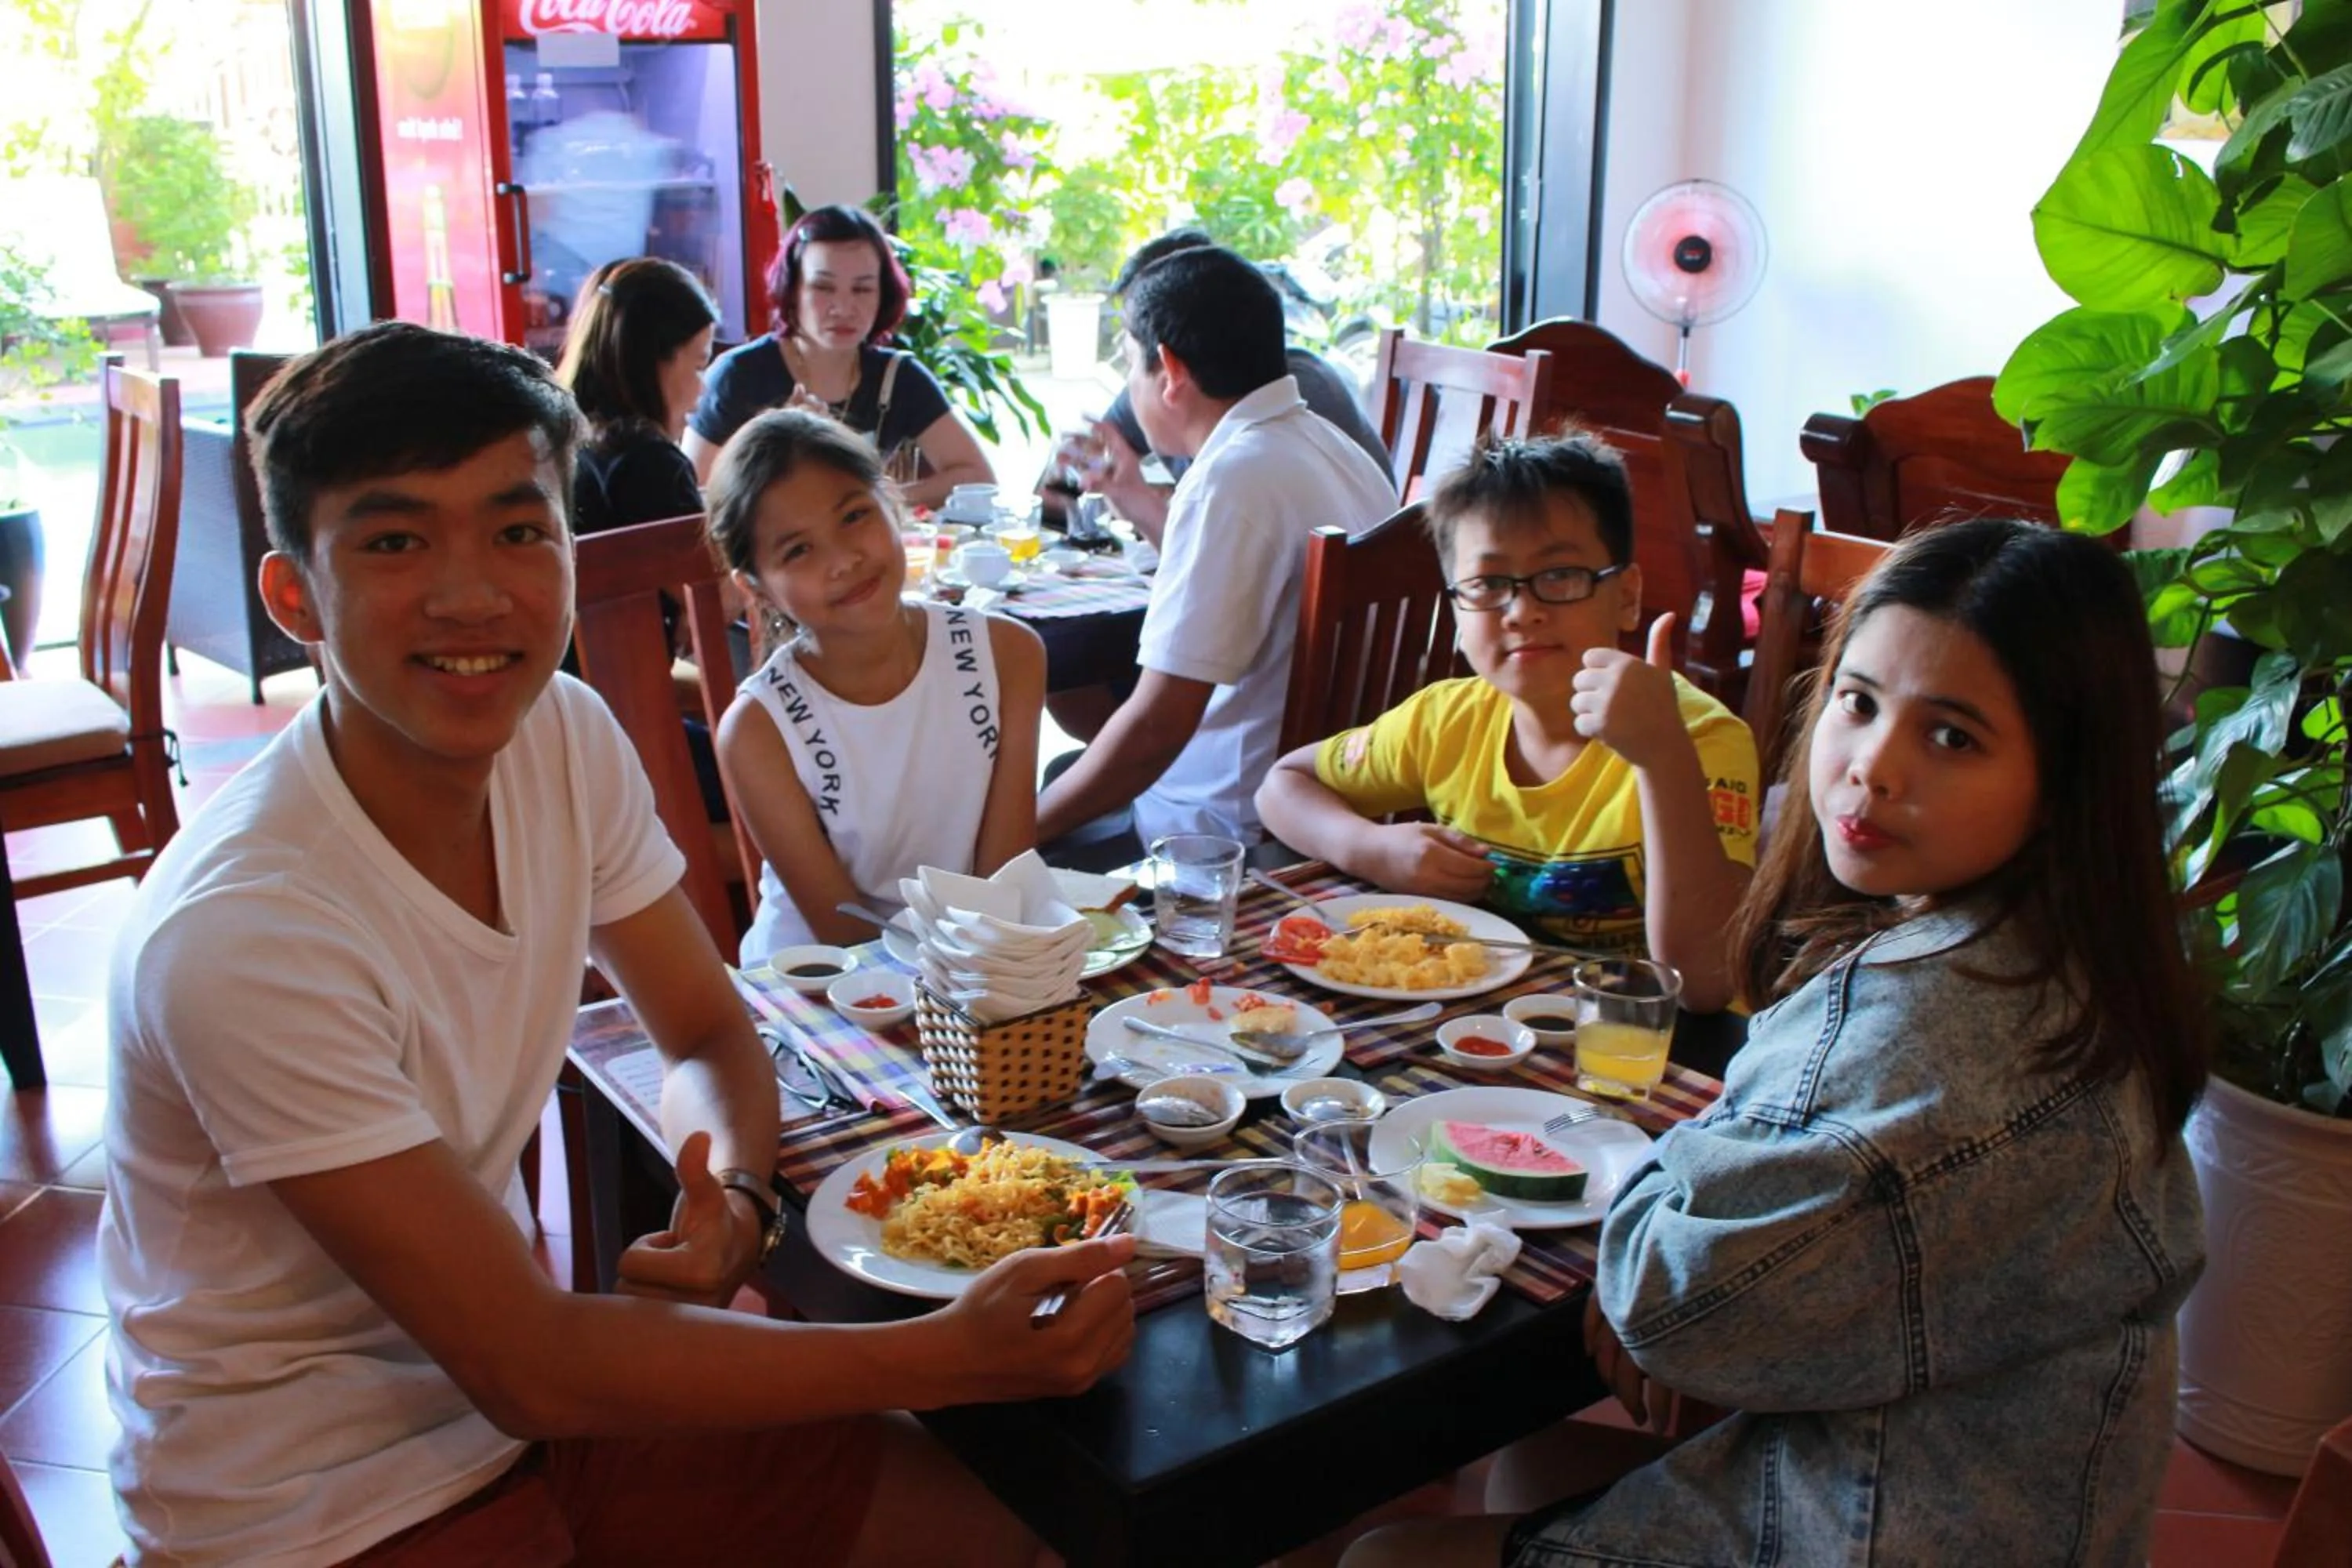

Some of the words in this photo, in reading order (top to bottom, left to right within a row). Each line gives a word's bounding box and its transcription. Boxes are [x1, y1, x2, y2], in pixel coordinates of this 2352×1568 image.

[769, 666, 814, 724] NEW
[805, 728, 841, 815] YORK
[946, 610, 978, 673] NEW
[964, 681, 999, 759] YOR
